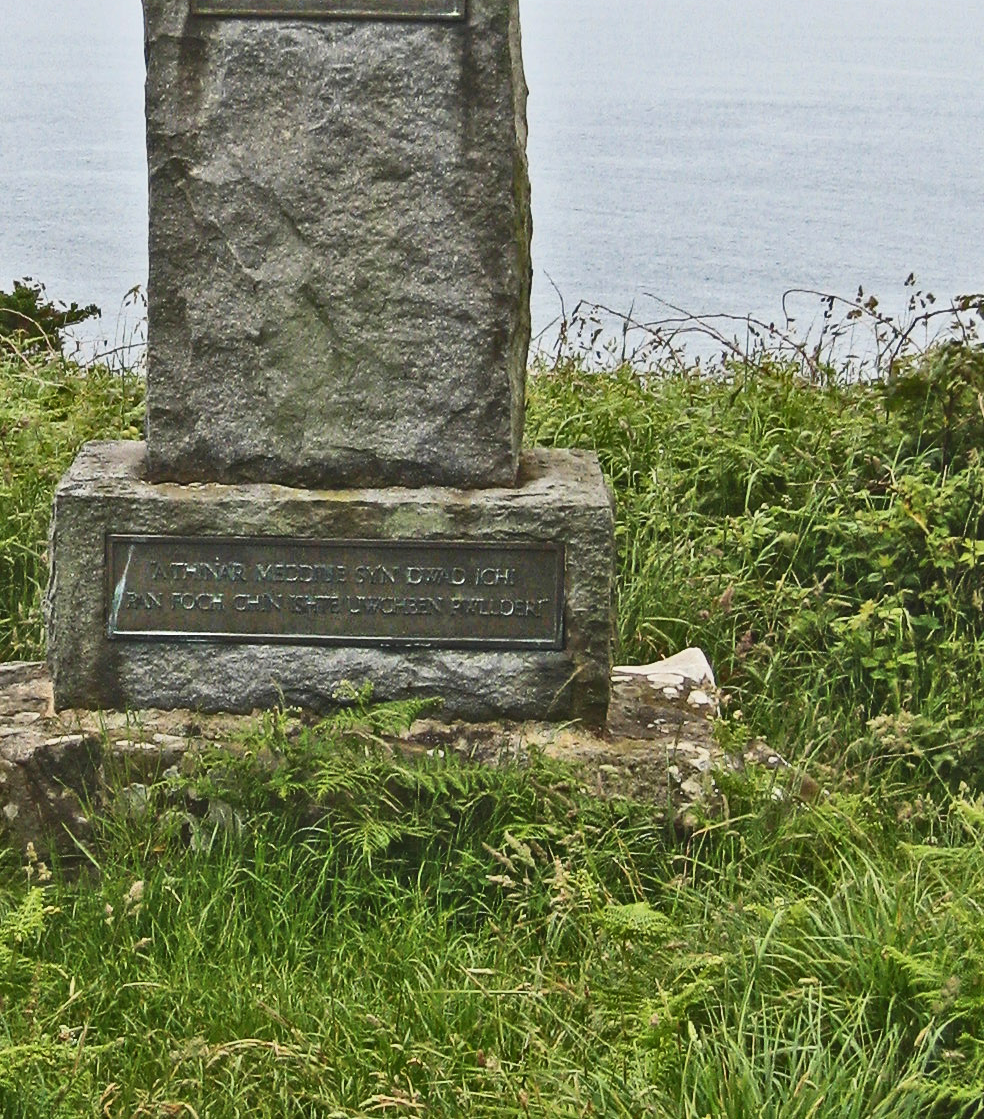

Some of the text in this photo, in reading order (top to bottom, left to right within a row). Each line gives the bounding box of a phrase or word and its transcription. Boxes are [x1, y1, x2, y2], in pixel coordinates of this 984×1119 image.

[406, 566, 465, 585] DWAD
[126, 591, 163, 610] PAN
[171, 591, 224, 611] FOCH
